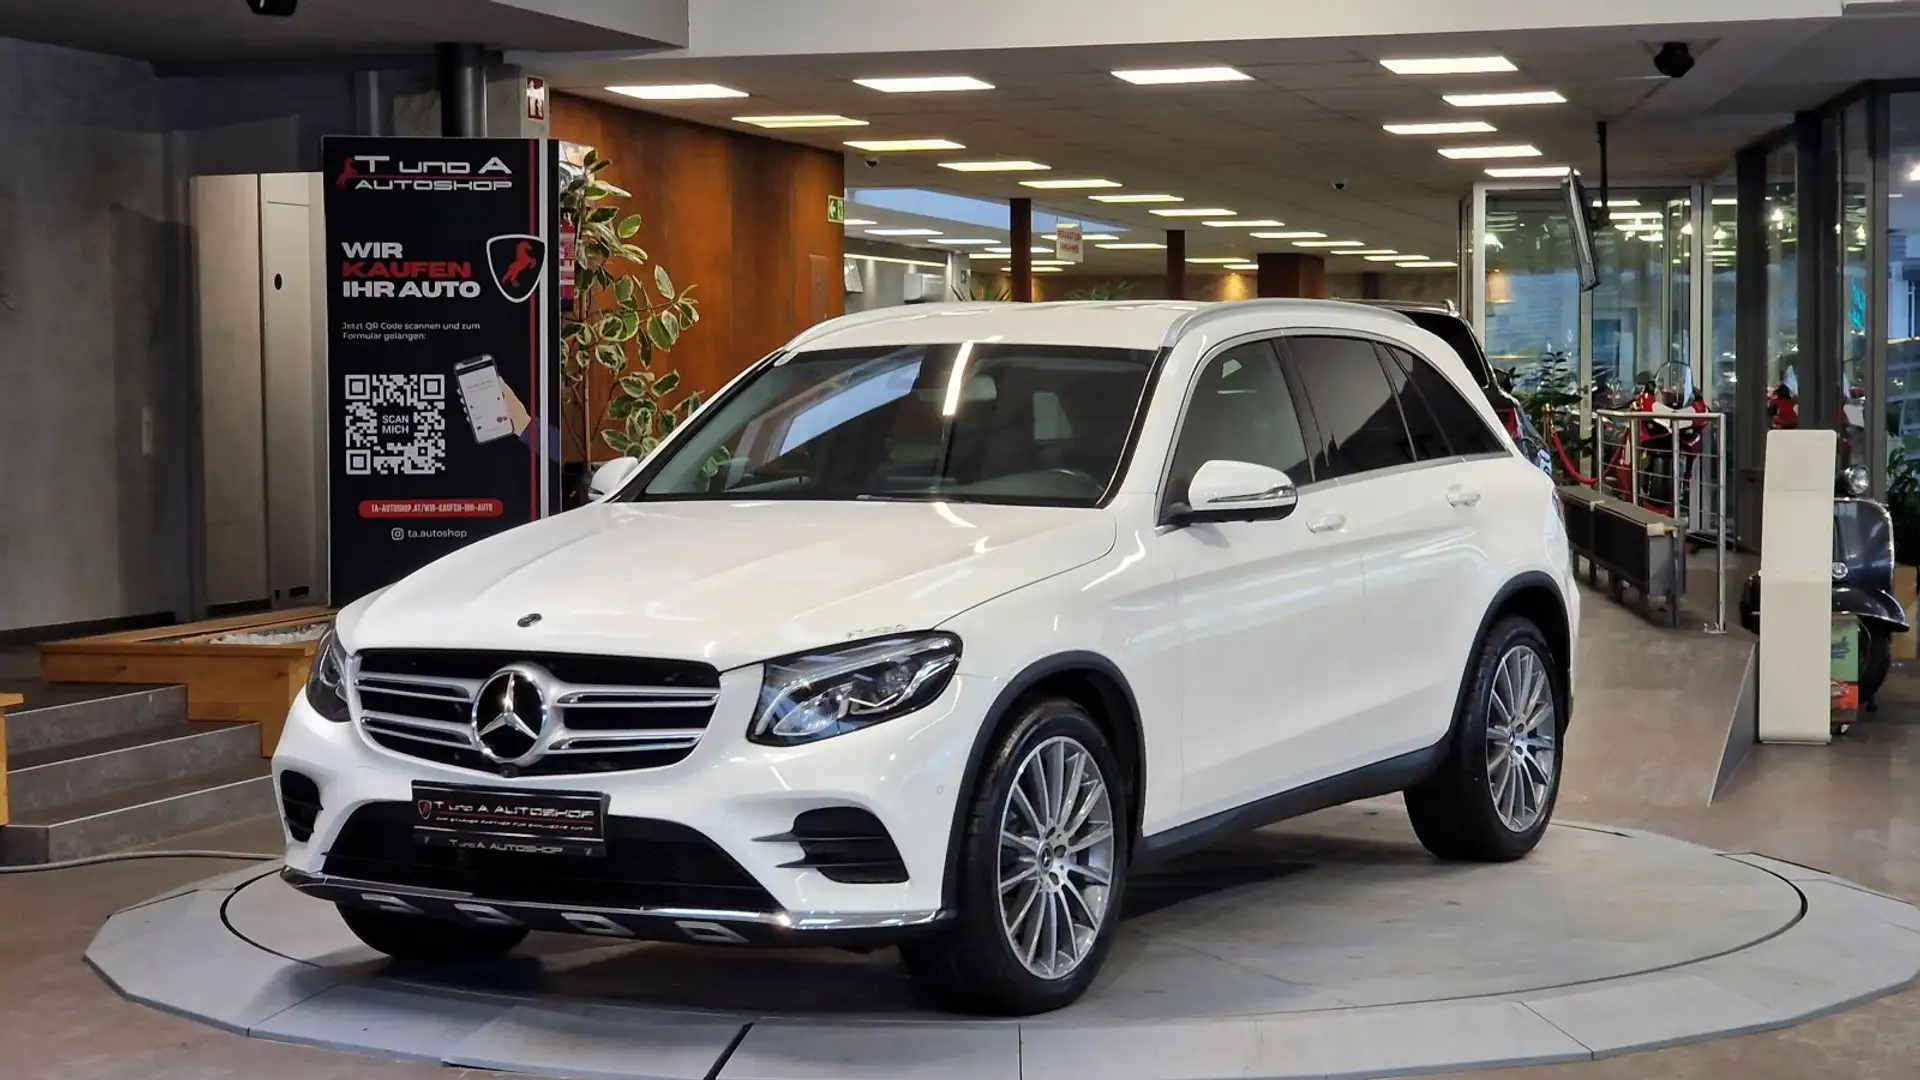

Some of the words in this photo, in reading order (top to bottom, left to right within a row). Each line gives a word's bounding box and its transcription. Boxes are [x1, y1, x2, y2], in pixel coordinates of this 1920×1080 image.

[355, 156, 389, 172] T
[478, 157, 512, 173] A
[356, 180, 512, 190] AUTOSHOP
[342, 242, 402, 258] WIR
[341, 262, 472, 278] KAUFEN
[344, 281, 394, 297] IHR
[399, 281, 480, 297] AUTO
[342, 322, 364, 330] Jetzt
[365, 322, 380, 331] QR
[380, 322, 403, 330] Code
[404, 322, 441, 330] scannen
[442, 322, 460, 330] und
[343, 332, 382, 340] Formular
[383, 332, 426, 342] gelangen:
[383, 415, 409, 423] SCAN
[382, 425, 409, 434] MICH
[408, 529, 467, 538] ta.autoshop
[477, 804, 489, 812] A
[494, 804, 595, 818] AUTOSHOP
[489, 842, 564, 854] AUTOSHOP
